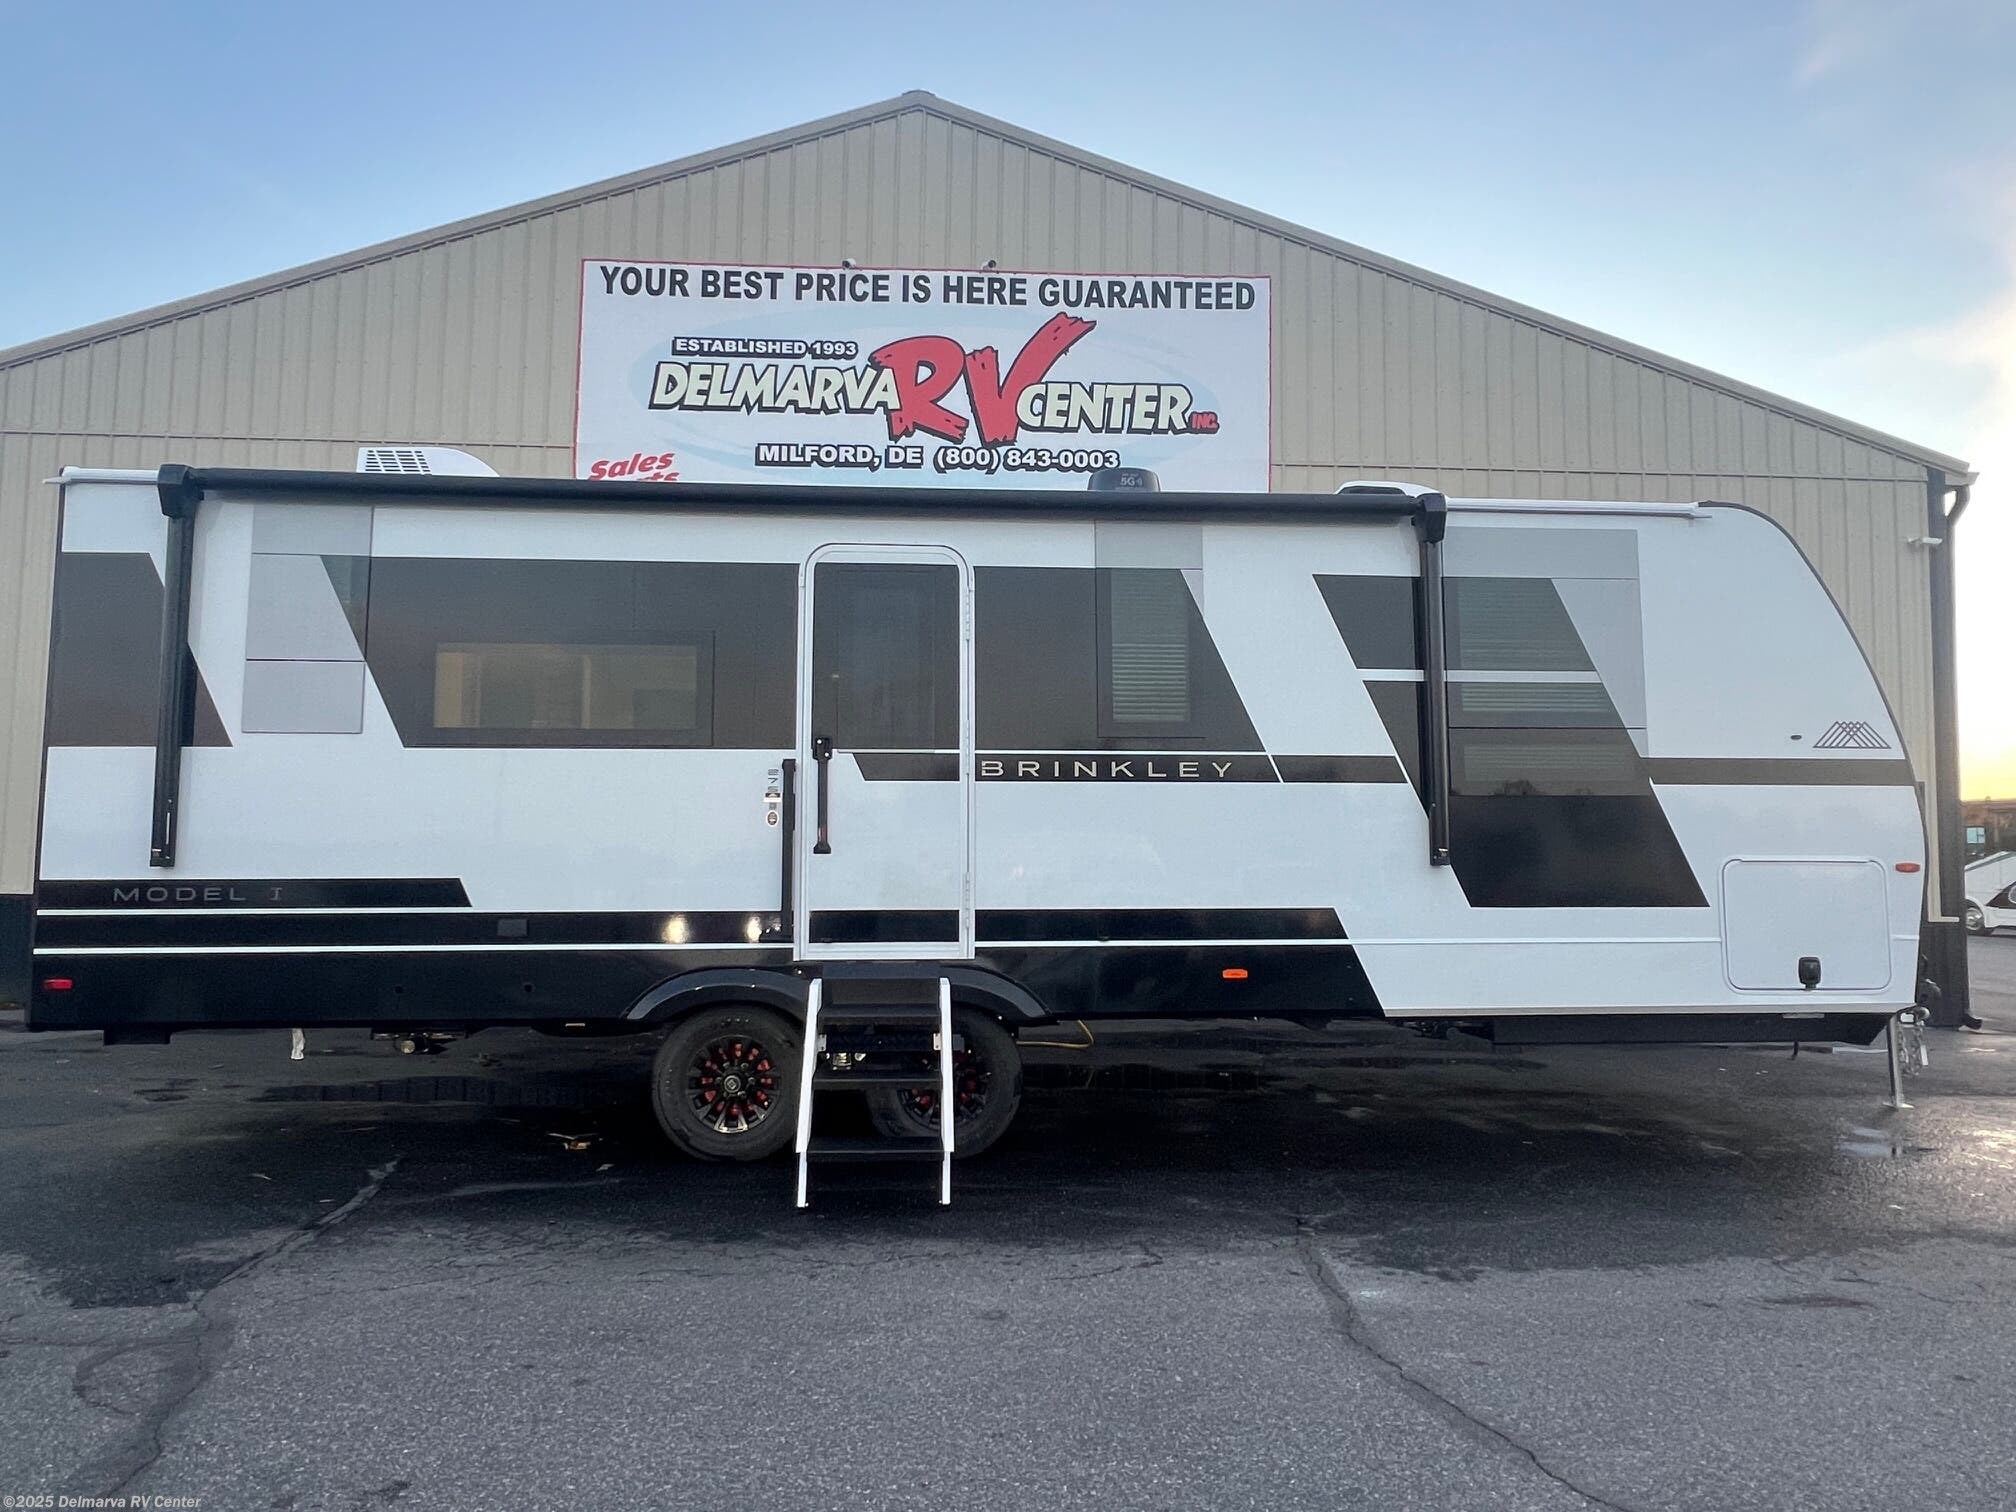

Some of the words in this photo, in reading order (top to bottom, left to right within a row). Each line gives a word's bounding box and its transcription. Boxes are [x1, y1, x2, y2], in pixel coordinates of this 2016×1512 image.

[600, 265, 689, 297] YOUR
[701, 269, 784, 300] BEST
[795, 272, 890, 303] PRICE
[902, 274, 932, 303] IS
[942, 275, 1028, 306] HERE
[1038, 279, 1256, 310] GUARANTEED
[674, 338, 807, 356] ESTABLISHED
[811, 341, 858, 357] 1993
[649, 361, 902, 413] DELMARVA
[868, 311, 1097, 448] RV
[1015, 381, 1194, 434] CENTER
[1188, 411, 1220, 434] INC.
[756, 443, 883, 471] MILFORD,
[885, 446, 924, 469] DE
[934, 447, 1000, 475] (800)
[1003, 449, 1121, 473] 843-0003
[980, 760, 1233, 778] BRINKLEY
[113, 887, 246, 902] MODEL
